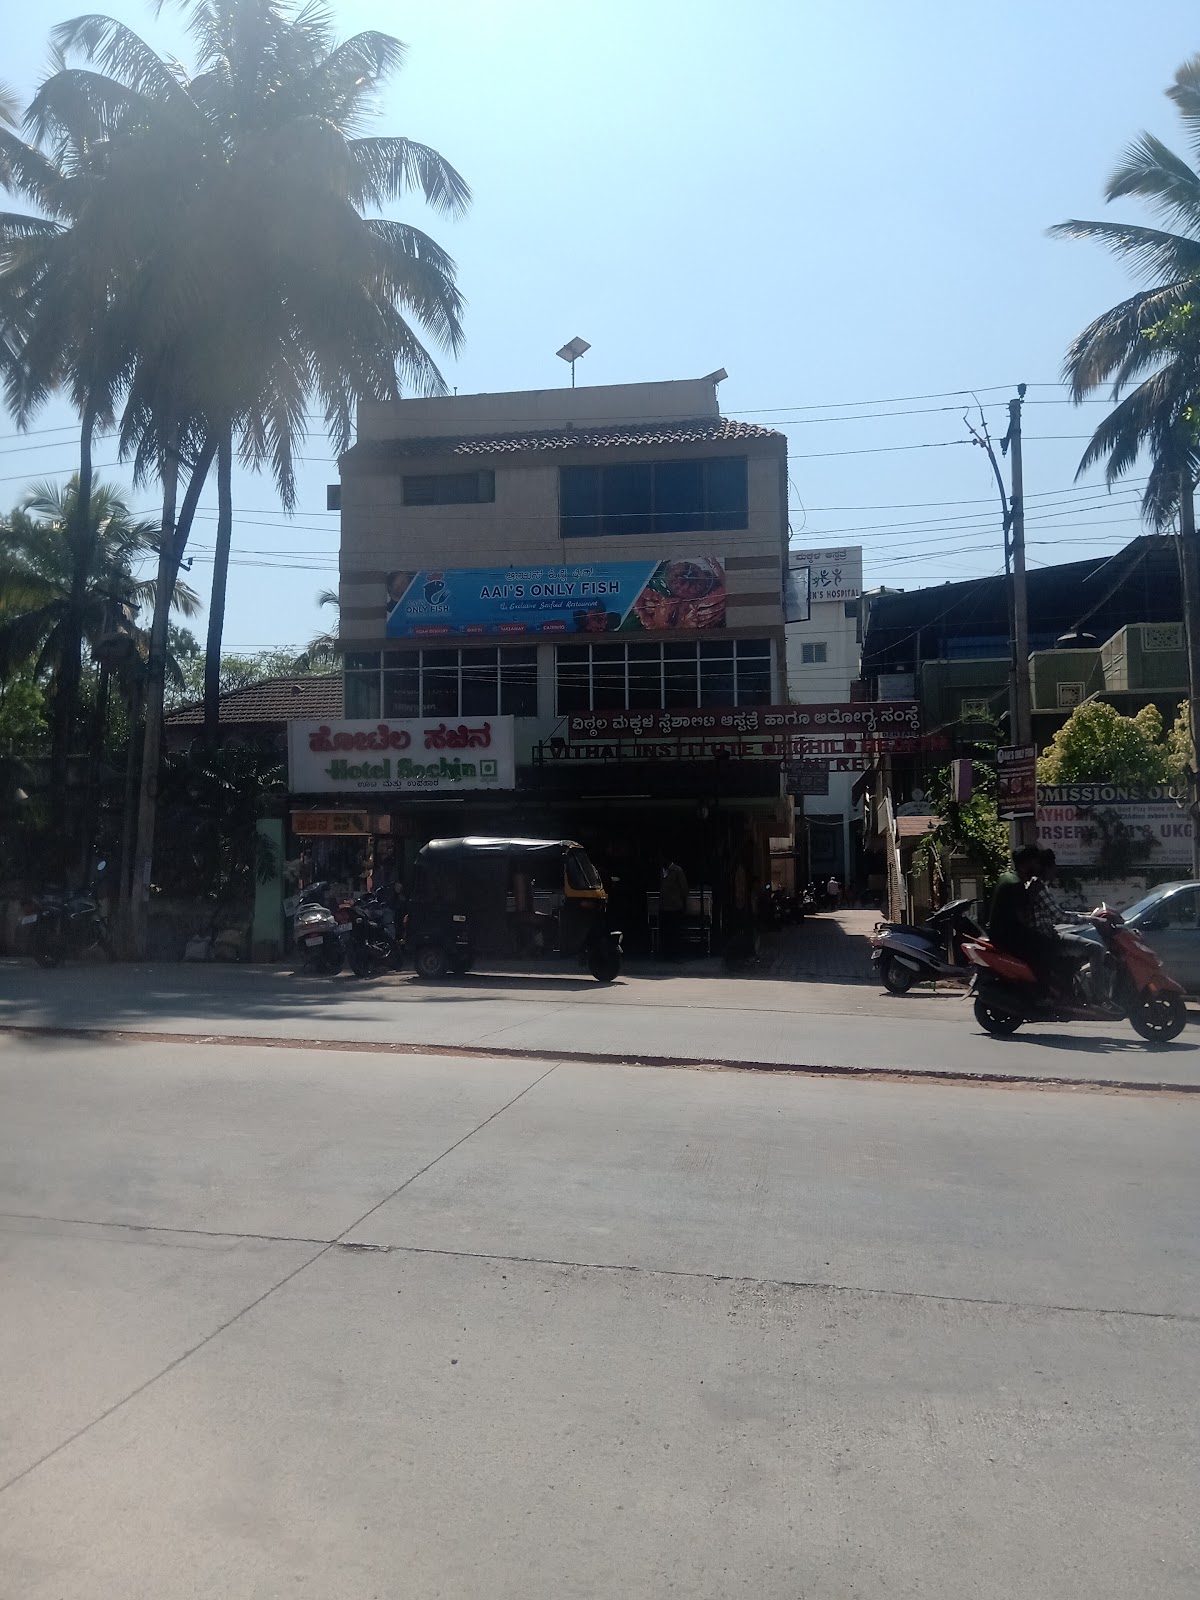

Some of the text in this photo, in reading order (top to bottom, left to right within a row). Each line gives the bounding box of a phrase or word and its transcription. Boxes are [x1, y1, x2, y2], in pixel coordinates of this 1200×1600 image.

[480, 580, 621, 599] AAI'S ONLY FISH
[827, 588, 860, 599] HOSPITAL
[405, 604, 450, 613] ONLY FISH
[612, 714, 654, 735] ಮಕ್ಕಳ
[720, 710, 760, 732] ಆಸ್ಪತ್ರೆ
[764, 710, 810, 725] ಹಾಗೂ
[814, 708, 878, 732] ಆರೋಗ್ಯ
[880, 705, 920, 731] ಸಂಸ್ಥೆ
[325, 757, 477, 781] Hotel Sachin
